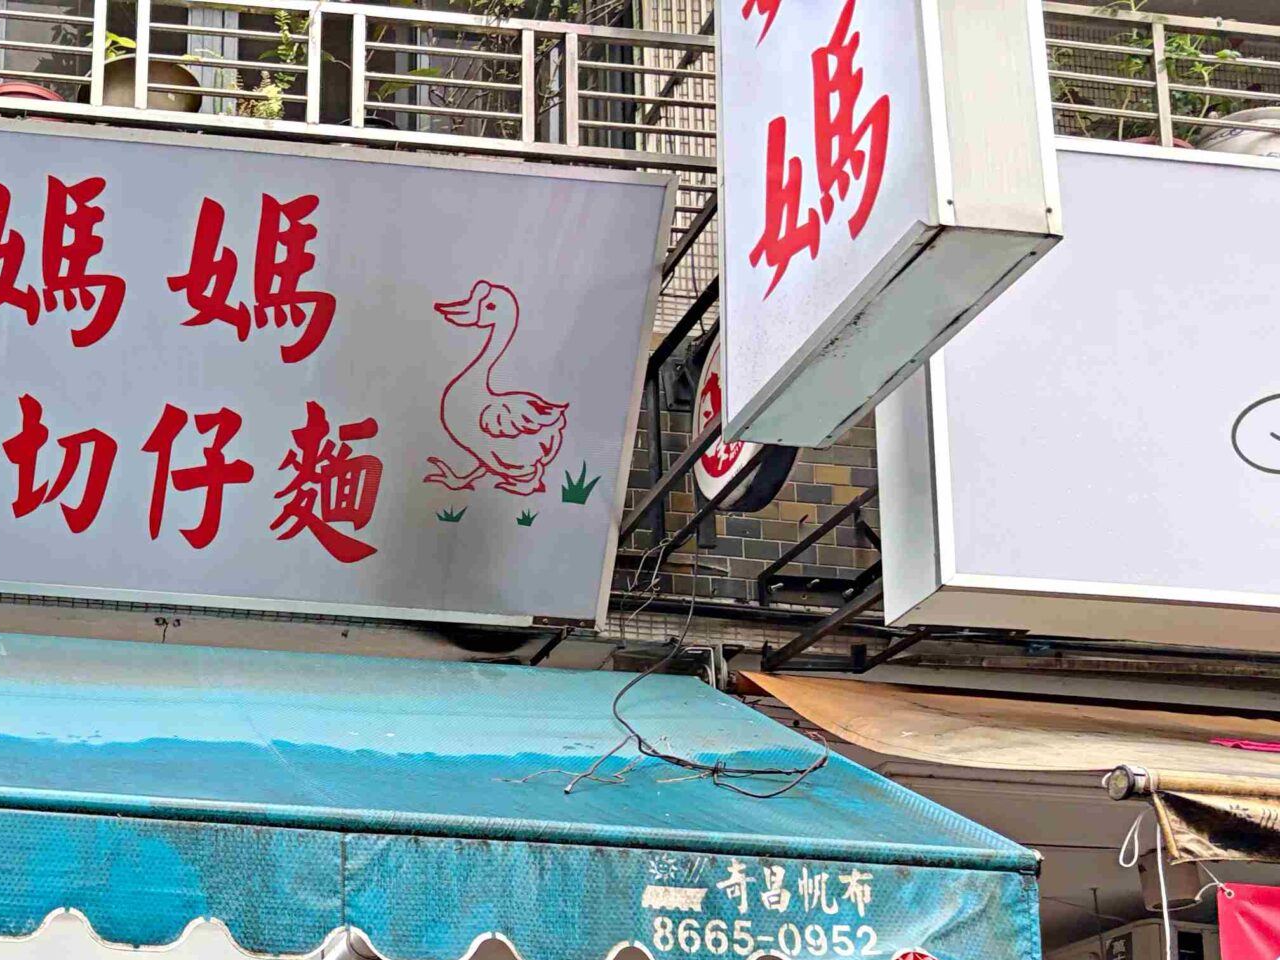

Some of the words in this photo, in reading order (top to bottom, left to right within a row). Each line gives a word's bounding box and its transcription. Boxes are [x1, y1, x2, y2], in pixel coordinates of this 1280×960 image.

[742, 0, 891, 301] 媽
[716, 858, 874, 917] 奇昌帆布
[652, 916, 882, 956] 8665-0952
